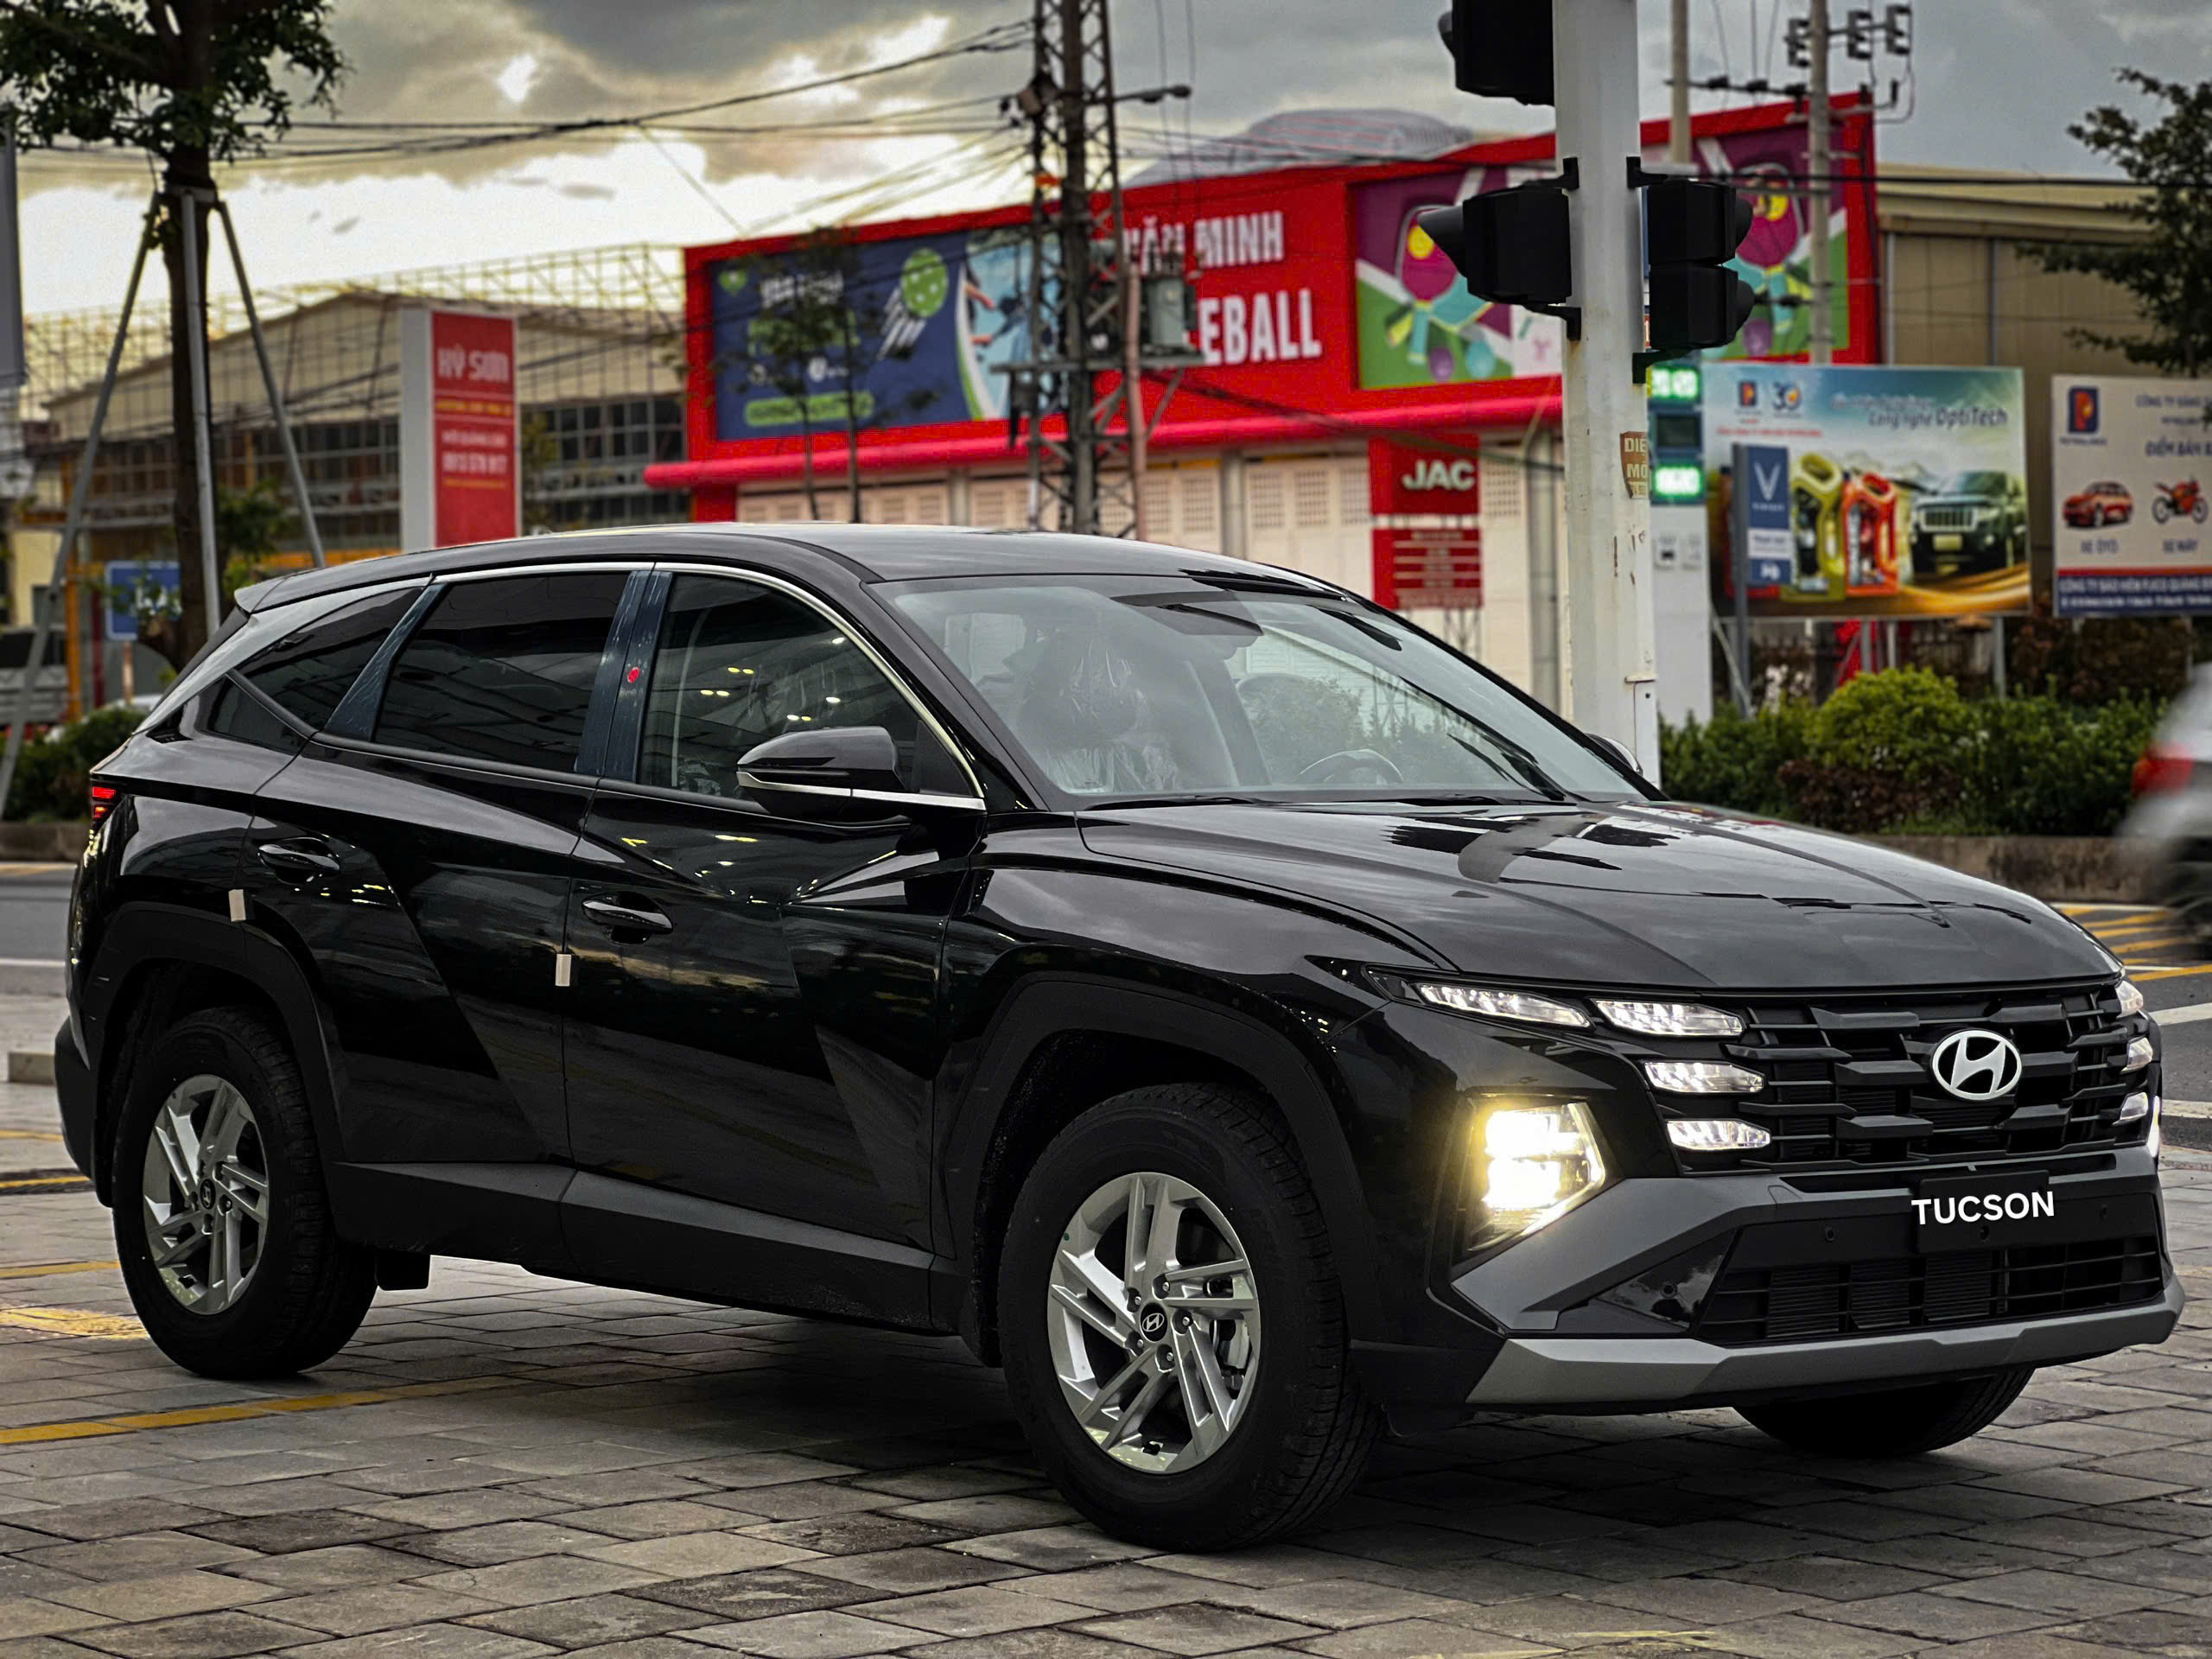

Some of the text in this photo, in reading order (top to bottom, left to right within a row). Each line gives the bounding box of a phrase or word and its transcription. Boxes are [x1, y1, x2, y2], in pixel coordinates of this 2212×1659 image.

[1193, 210, 1284, 270] MINH
[1182, 288, 1322, 365] EBALL
[1402, 459, 1476, 491] JAC
[1910, 1191, 2055, 1225] TUCSON
